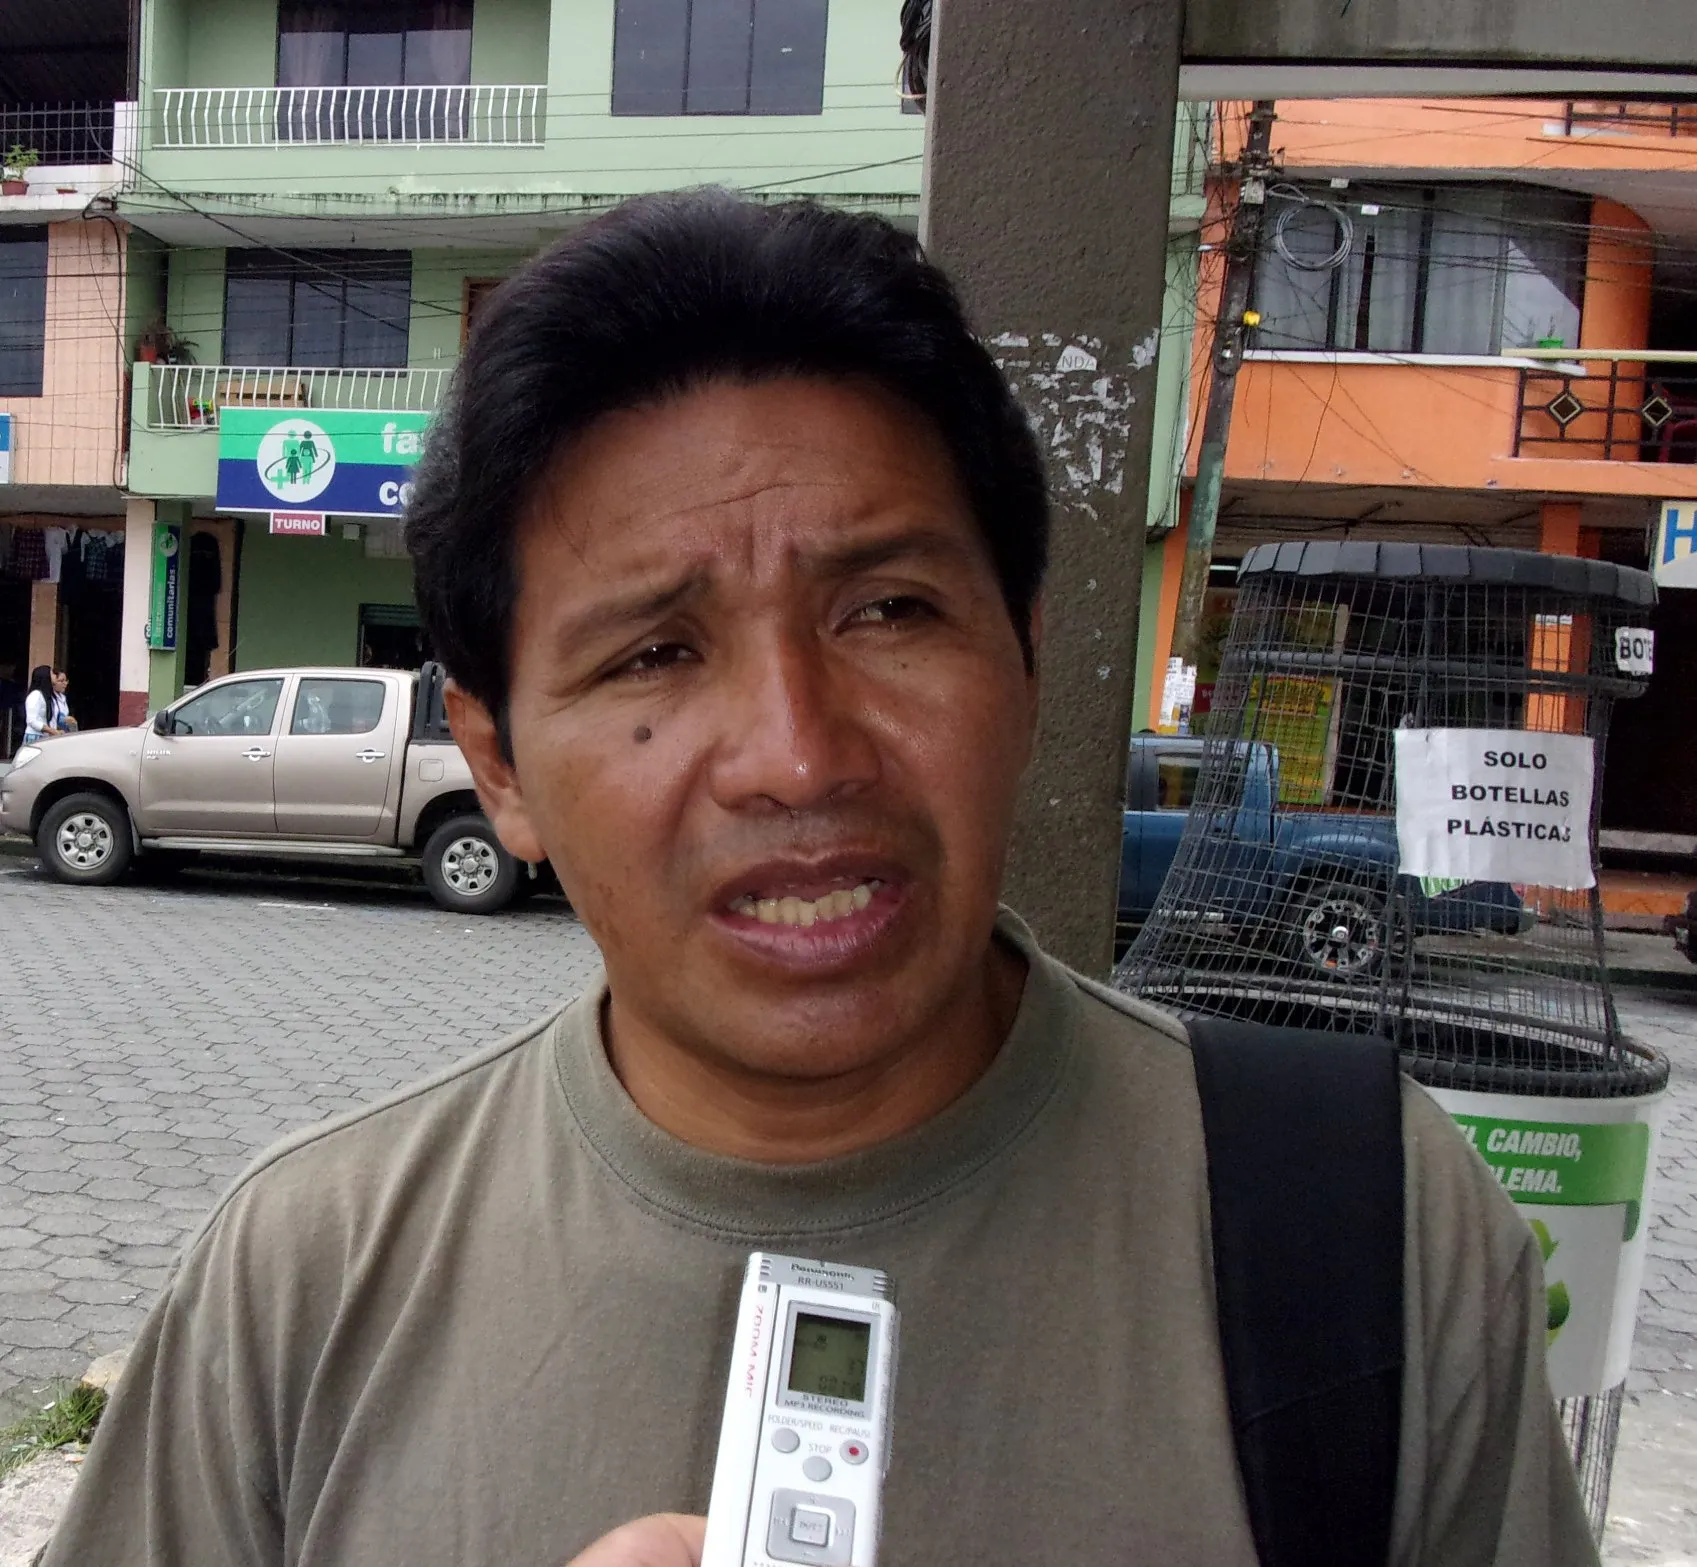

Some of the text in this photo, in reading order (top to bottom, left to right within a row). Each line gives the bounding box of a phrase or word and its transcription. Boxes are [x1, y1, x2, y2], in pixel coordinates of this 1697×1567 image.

[274, 518, 321, 531] TURNO
[166, 566, 177, 639] comunitarias
[1484, 750, 1547, 770] SOLO
[1451, 784, 1569, 807] BOTELLAS
[1487, 1128, 1582, 1162] CAMBIO,
[750, 1305, 764, 1357] ZOOM
[803, 1394, 849, 1407] STEREO
[808, 1403, 865, 1418] RECORDING
[808, 1443, 832, 1454] STOP
